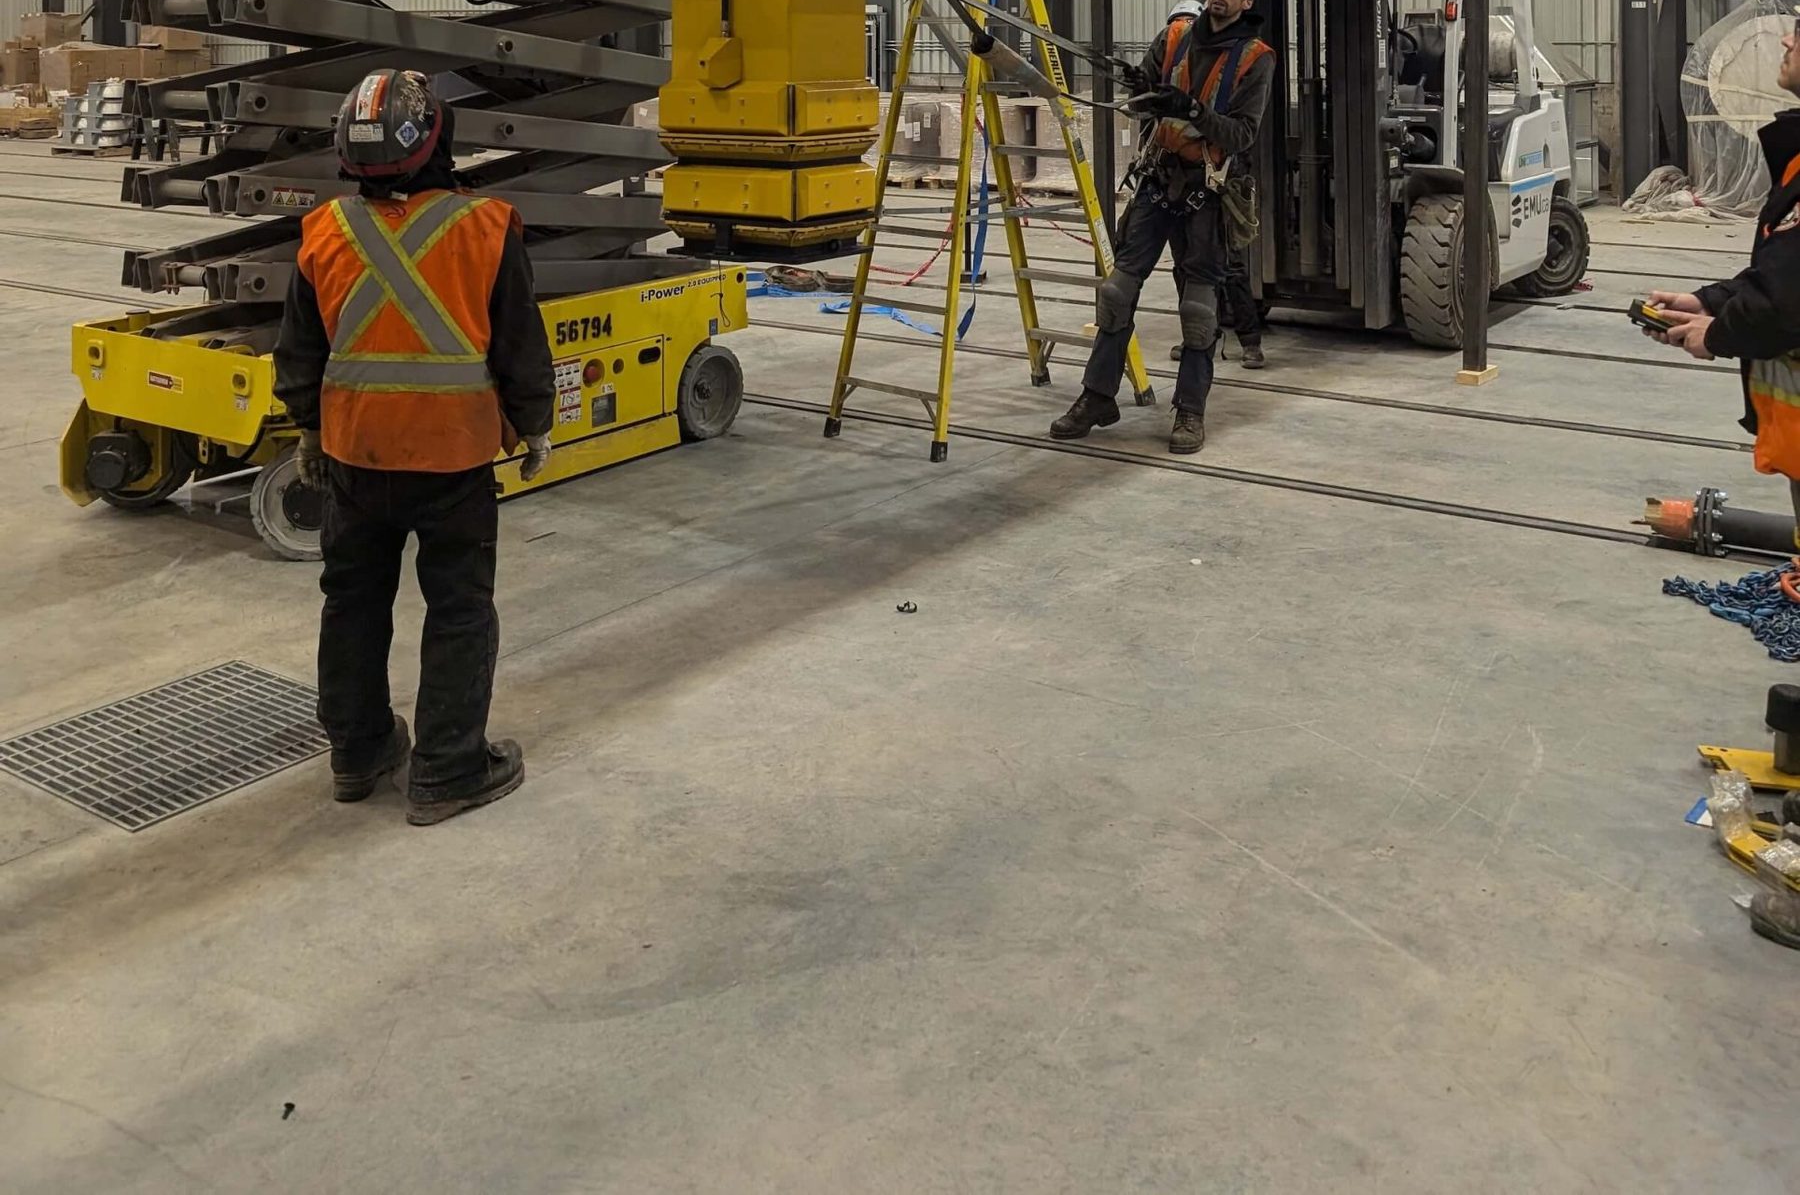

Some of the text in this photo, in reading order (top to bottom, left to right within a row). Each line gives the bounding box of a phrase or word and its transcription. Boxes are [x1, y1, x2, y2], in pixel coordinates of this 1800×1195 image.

[1040, 23, 1065, 87] FTHERLITE
[640, 284, 685, 302] i-Power
[697, 273, 727, 286] EQUIPPED
[555, 312, 612, 346] 56794
